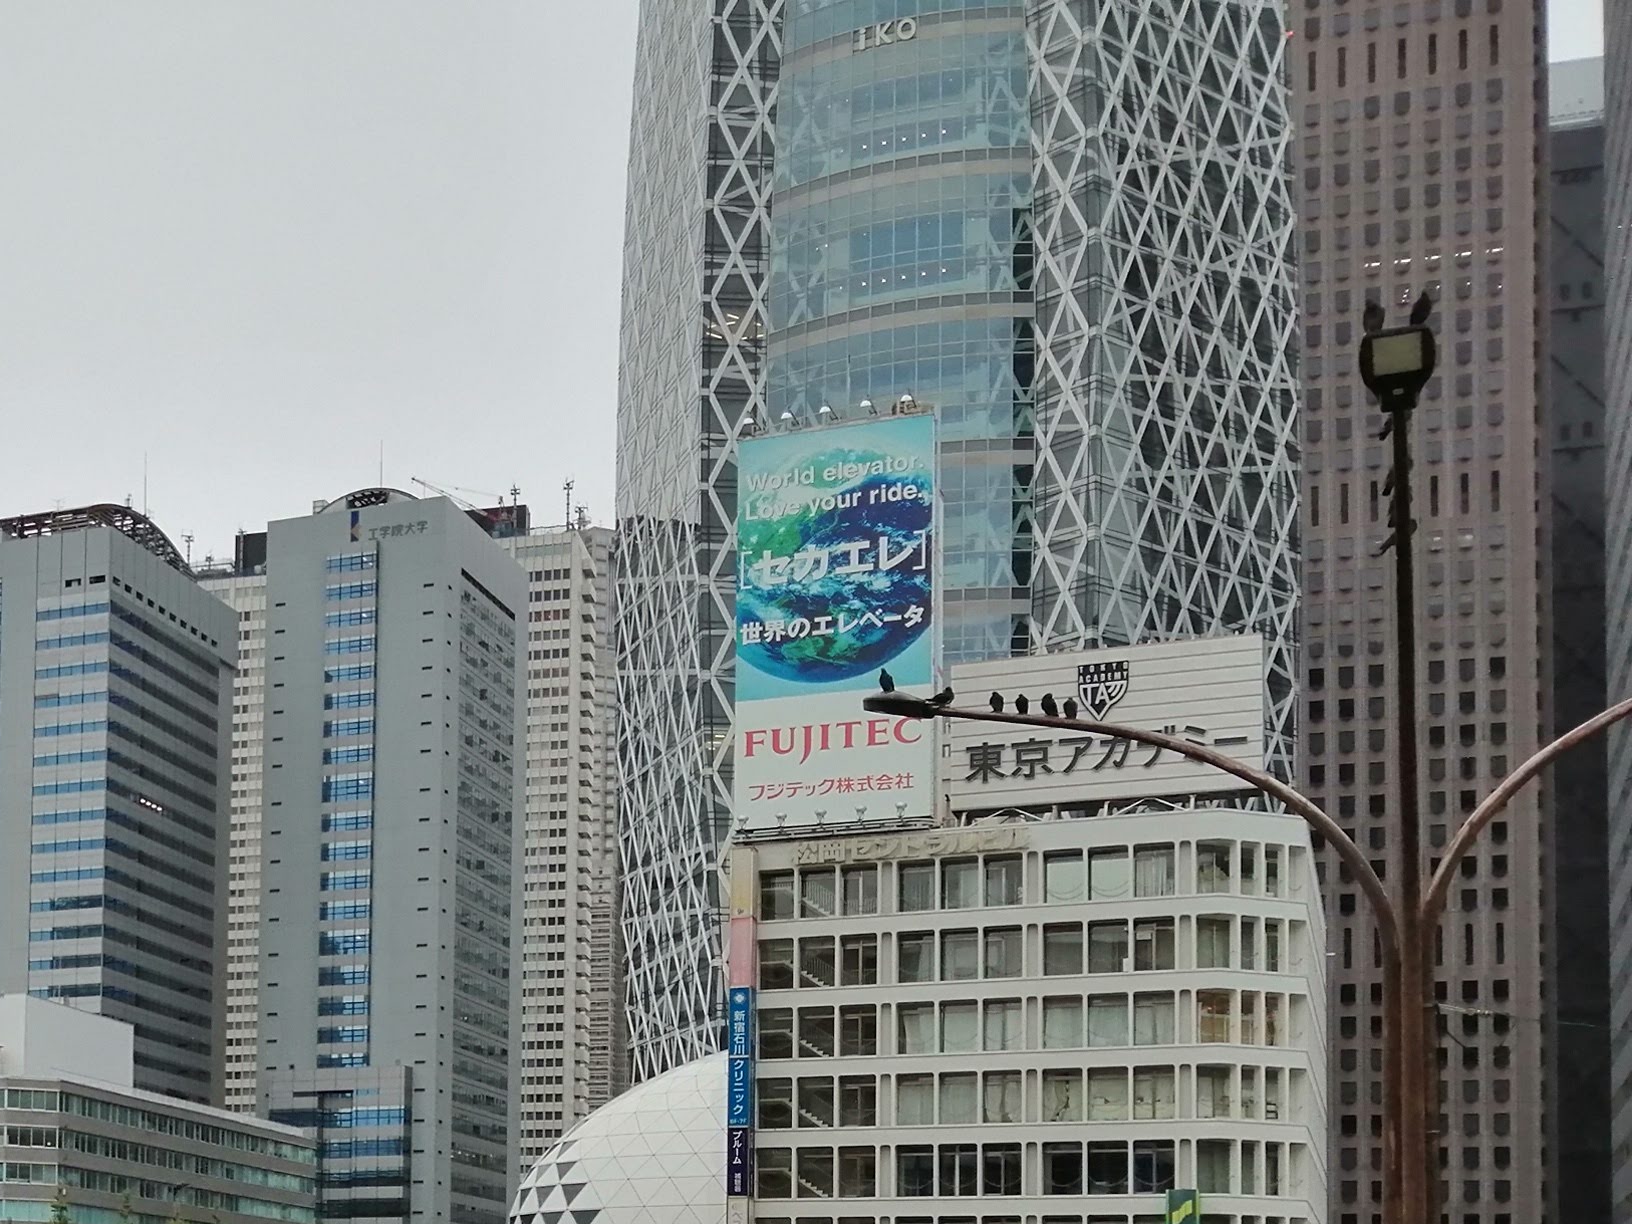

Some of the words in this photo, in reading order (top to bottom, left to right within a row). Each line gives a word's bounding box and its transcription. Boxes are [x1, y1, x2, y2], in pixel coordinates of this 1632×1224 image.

[748, 465, 815, 492] World
[823, 455, 924, 481] elevator.
[745, 499, 800, 521] Love
[808, 490, 862, 517] your
[869, 482, 923, 505] ride.
[368, 520, 428, 541] 工学院大学
[740, 604, 925, 646] 世界のエレベータ
[1078, 661, 1129, 674] TOKYO
[1079, 671, 1129, 684] ACADEMY
[743, 716, 923, 765] FUJITEC
[749, 772, 915, 801] フジテック株式会社
